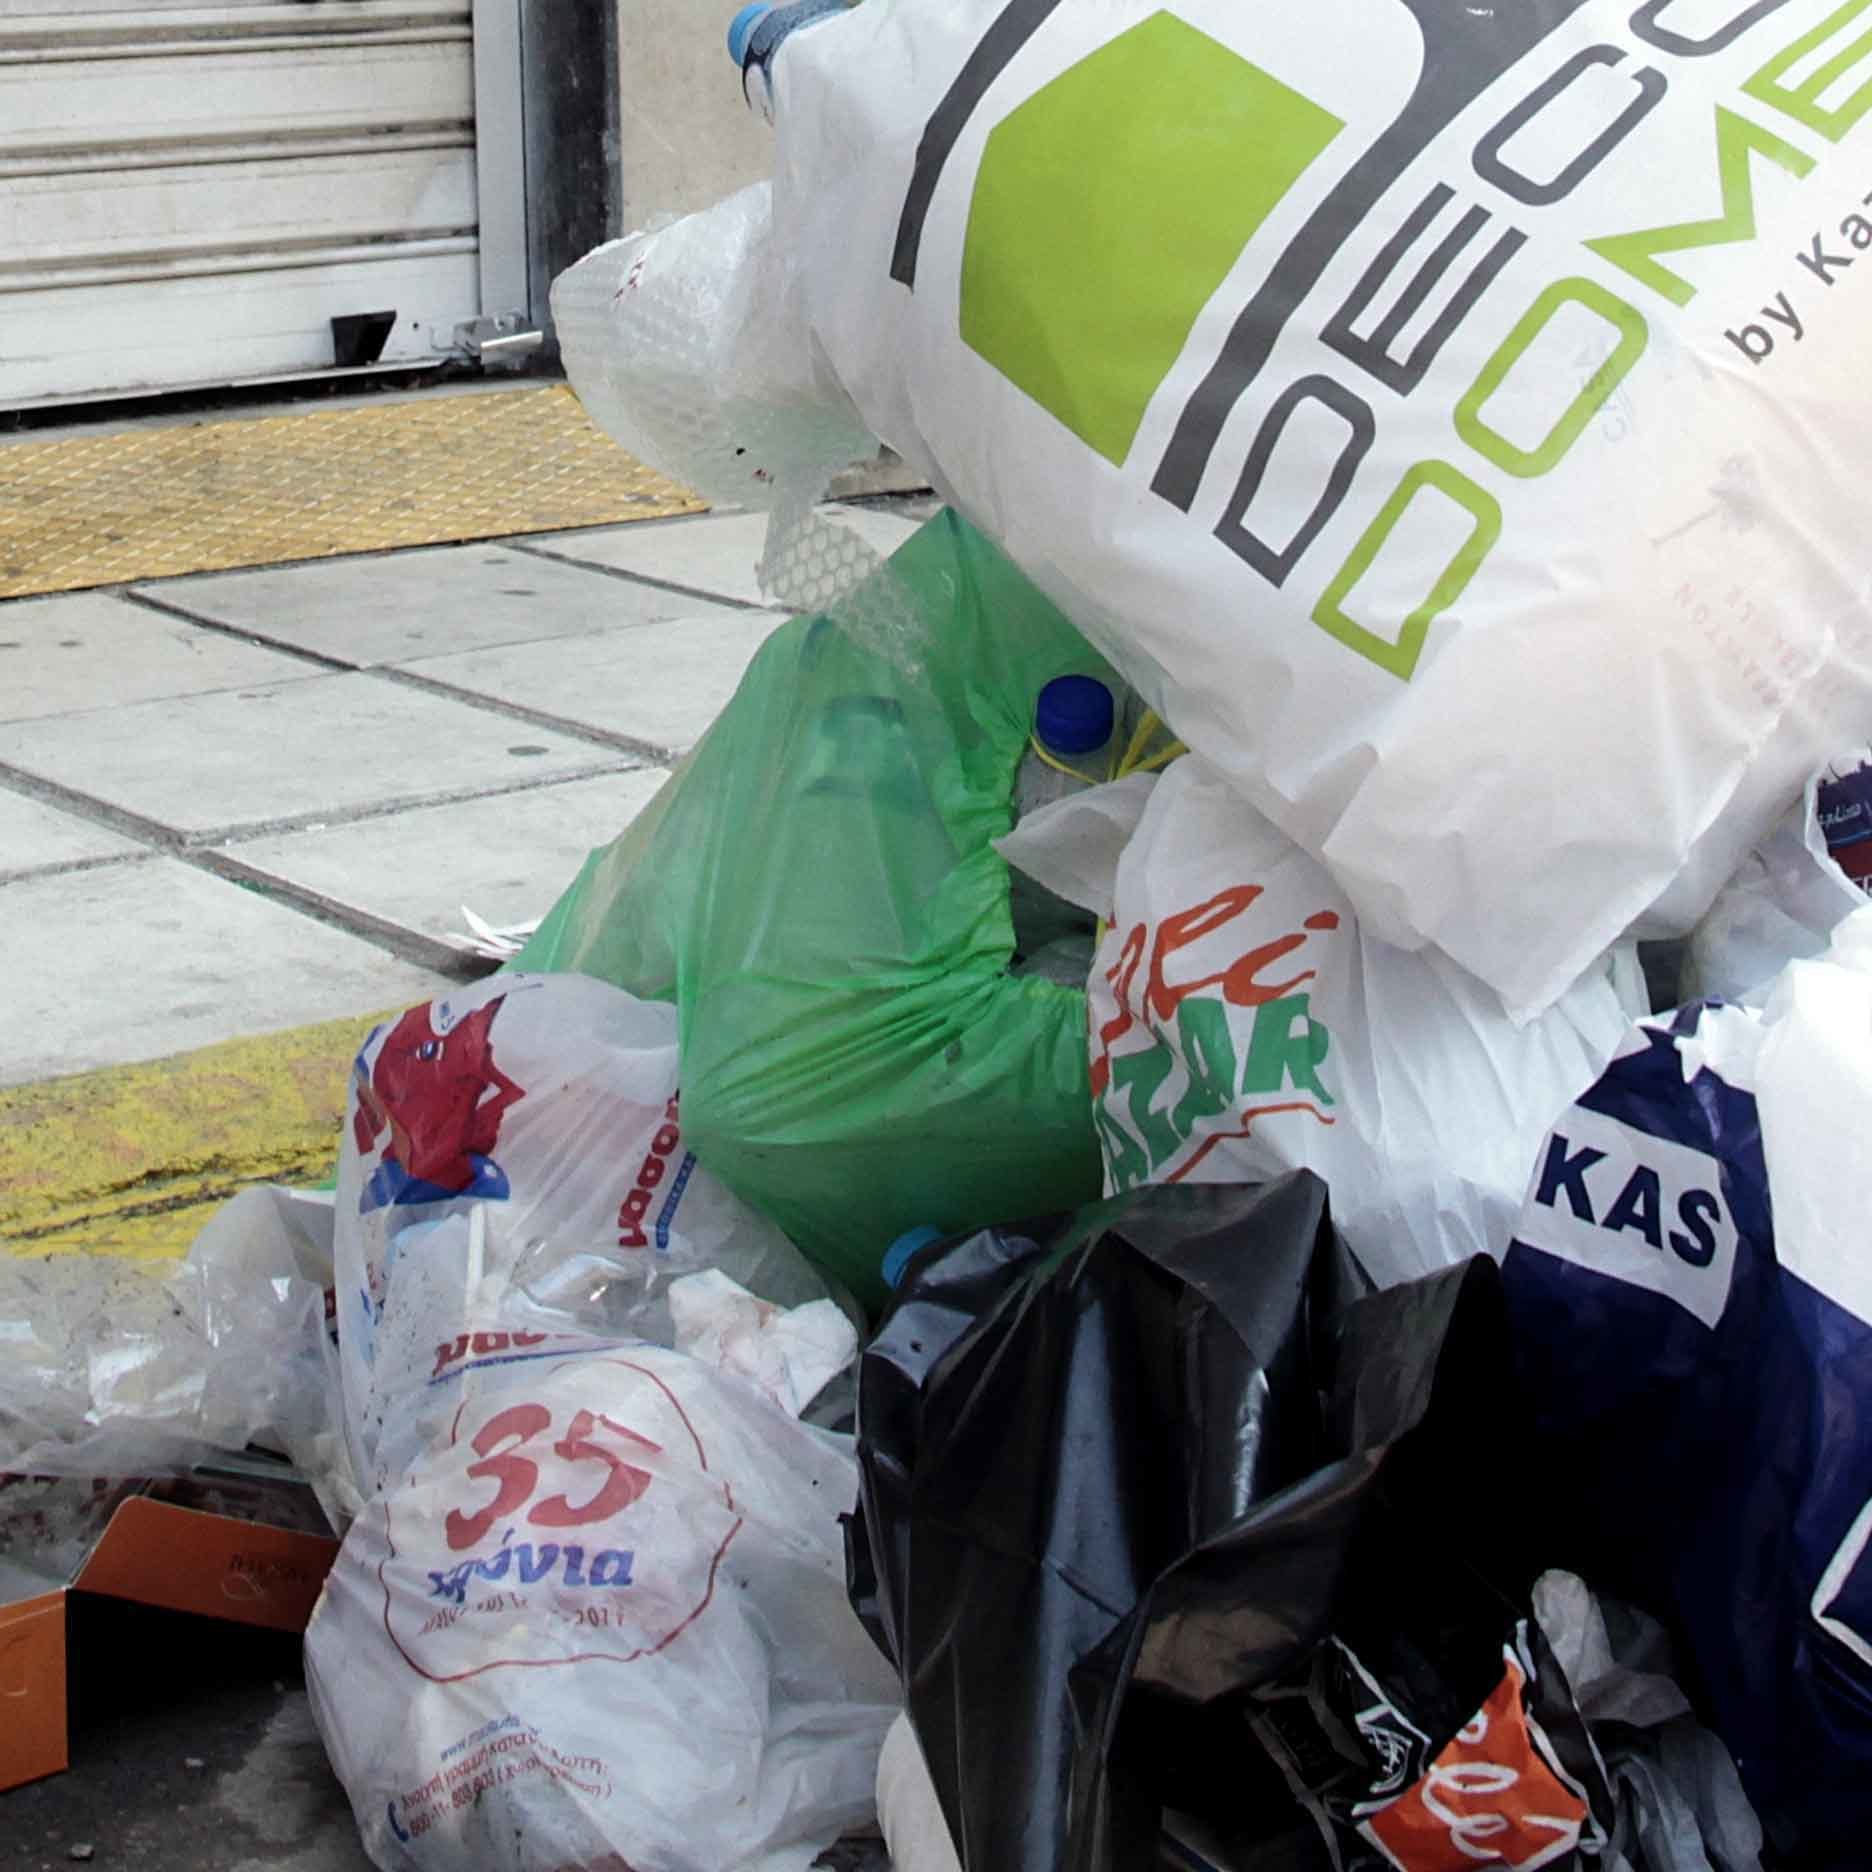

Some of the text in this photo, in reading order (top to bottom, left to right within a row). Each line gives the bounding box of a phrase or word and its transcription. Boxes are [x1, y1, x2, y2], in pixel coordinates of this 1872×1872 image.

[1723, 290, 1807, 367] by
[1533, 1130, 1722, 1270] KAS
[444, 1402, 663, 1552] 35
